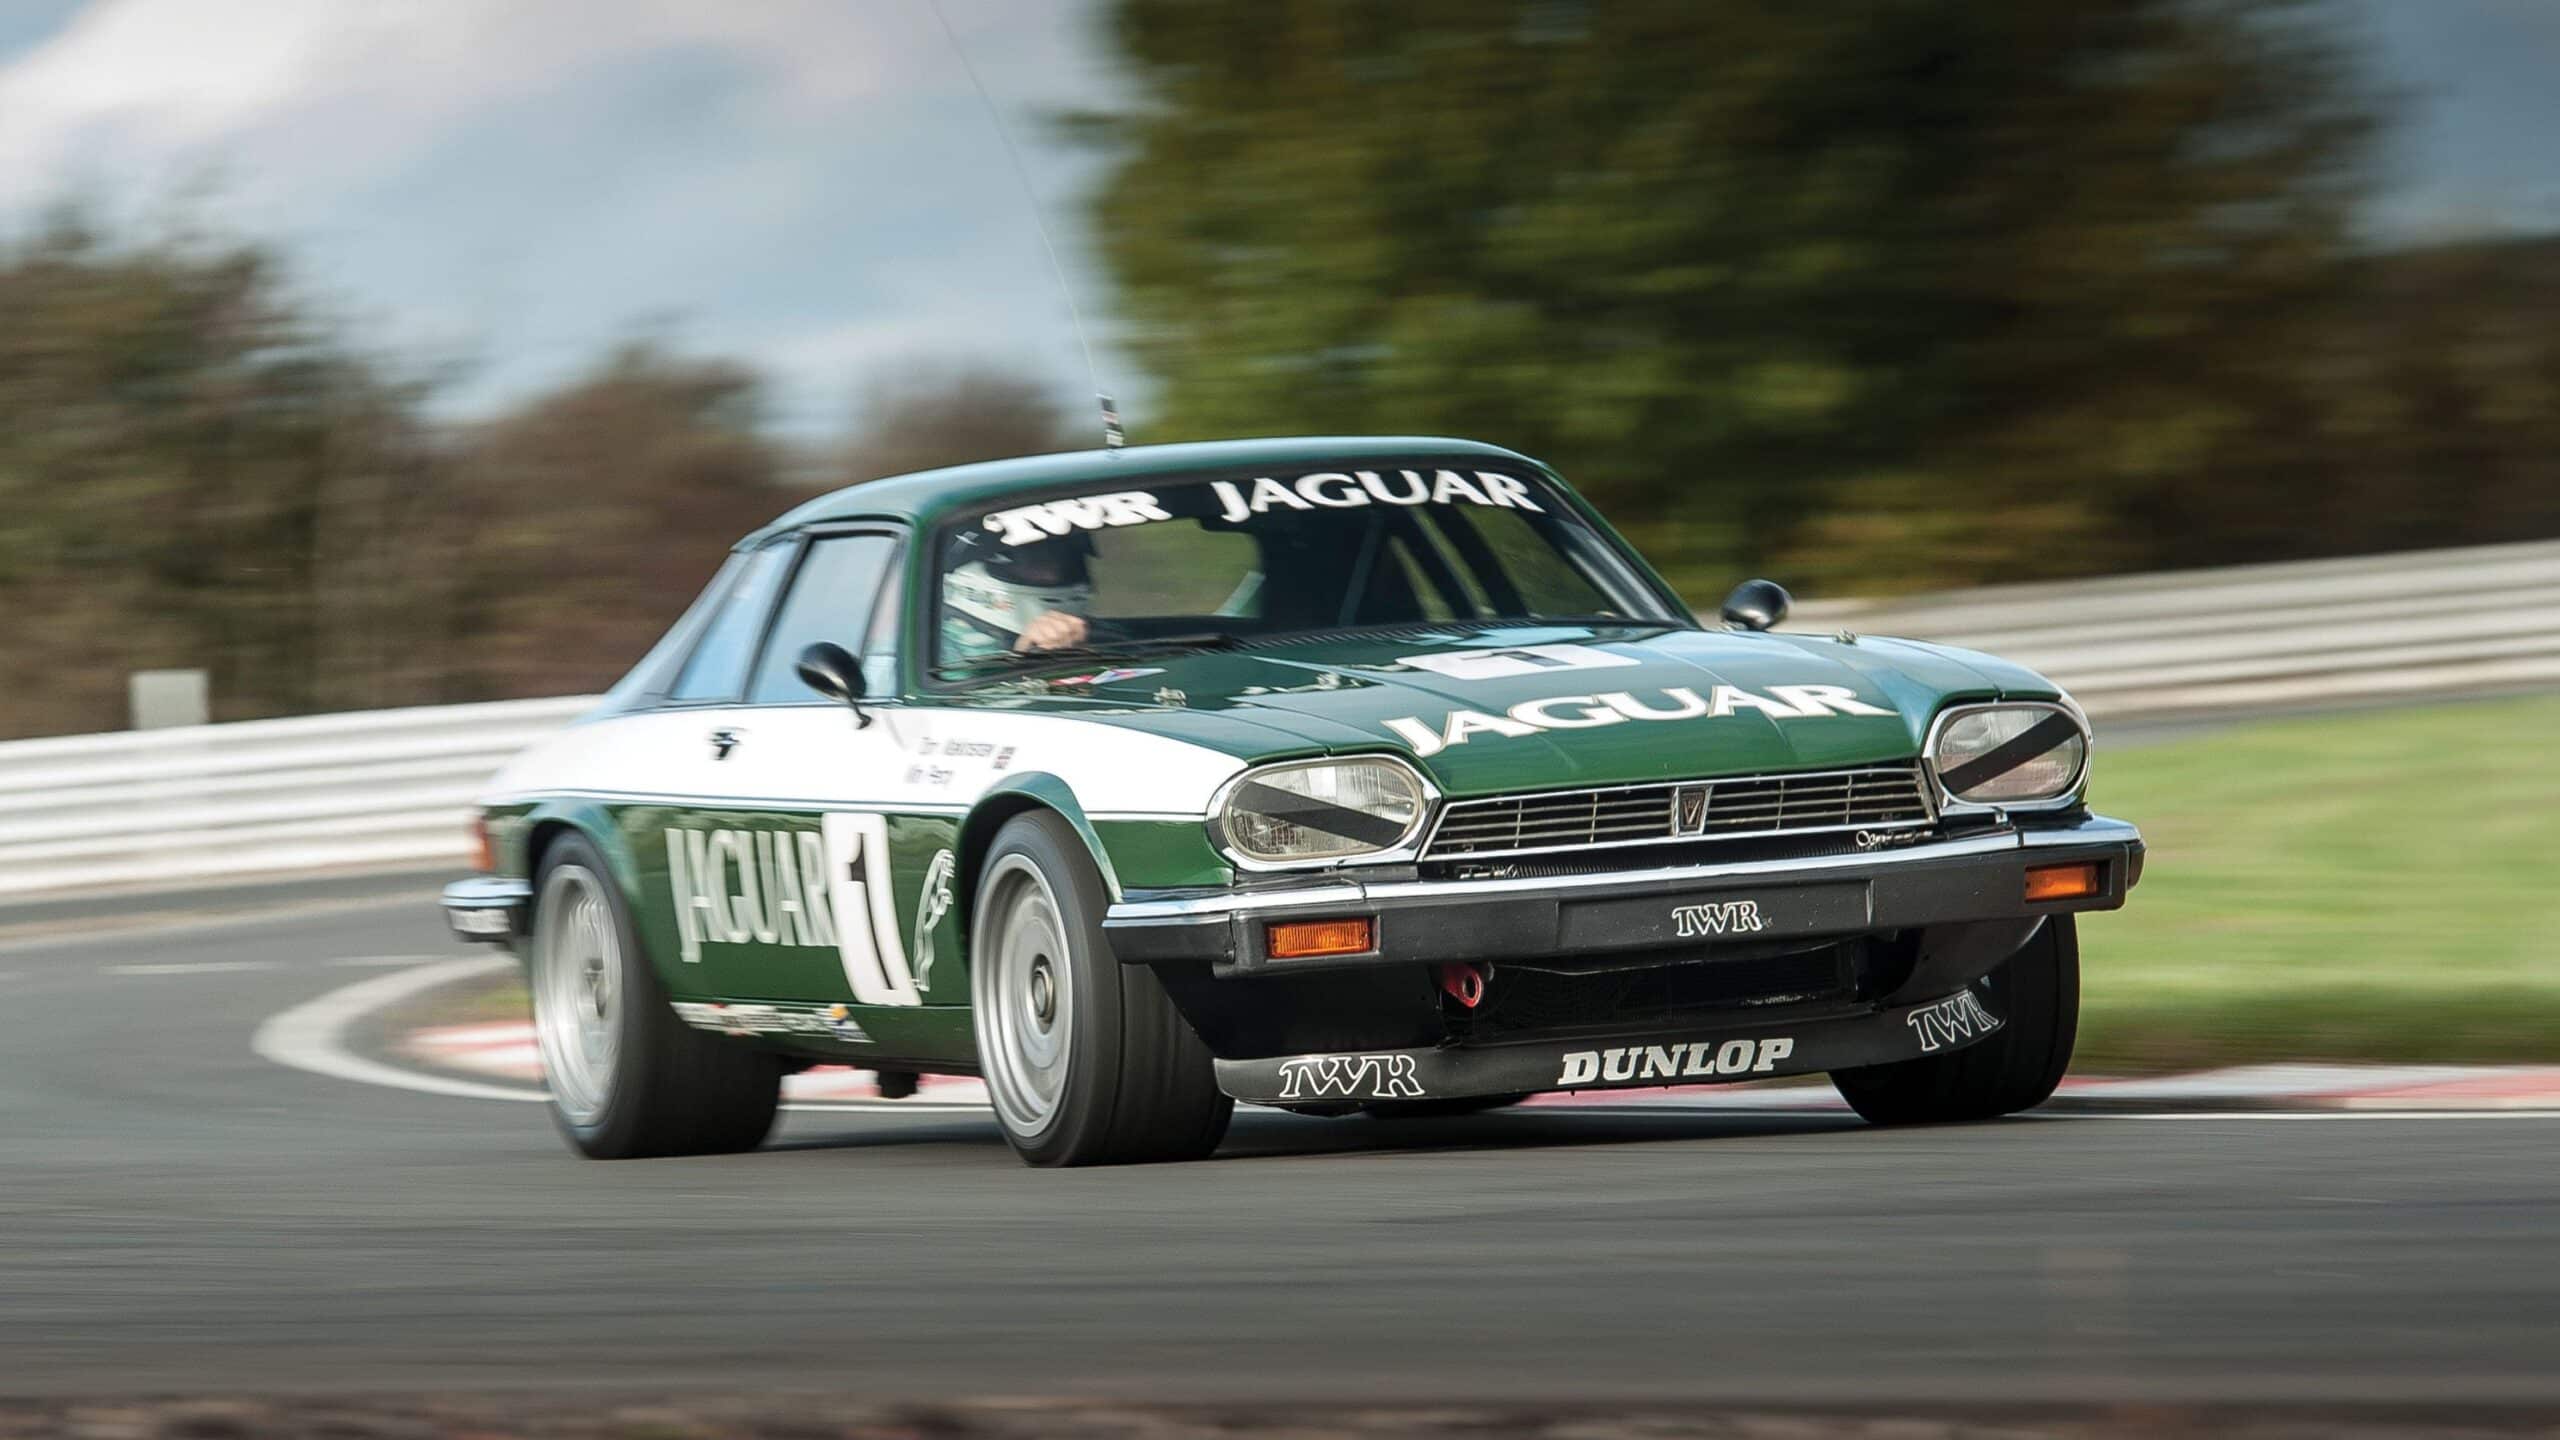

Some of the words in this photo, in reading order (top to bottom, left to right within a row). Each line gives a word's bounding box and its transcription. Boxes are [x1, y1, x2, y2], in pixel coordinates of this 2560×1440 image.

[982, 491, 1172, 546] TWR
[1211, 469, 1546, 523] JAGUAR
[1461, 649, 1573, 667] 1
[1381, 684, 1901, 758] JAGUAR
[664, 828, 840, 963] JAGUAR
[849, 832, 898, 991] 1
[1671, 900, 1763, 937] TWR
[1279, 1054, 1425, 1098] TWR
[1556, 1037, 1794, 1086] DUNLOP
